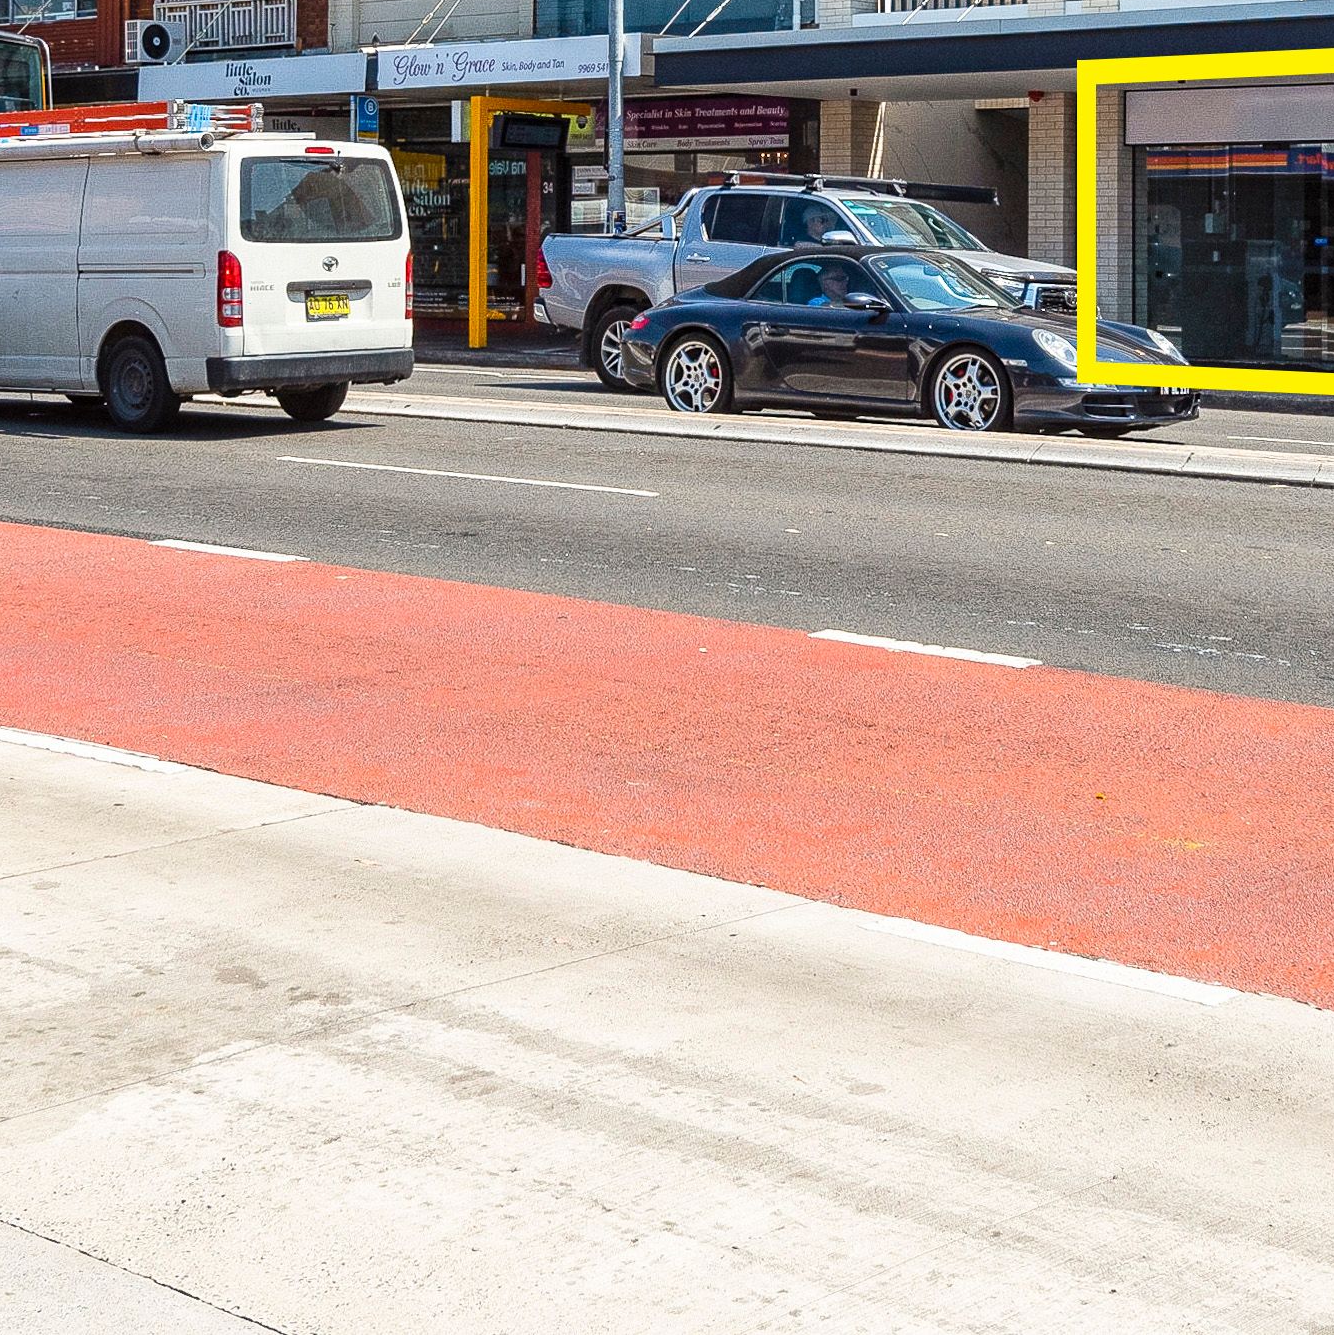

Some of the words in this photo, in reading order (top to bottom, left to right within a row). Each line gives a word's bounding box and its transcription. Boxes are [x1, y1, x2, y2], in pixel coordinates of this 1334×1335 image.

[225, 62, 253, 78] little
[393, 55, 431, 85] Glow
[452, 51, 495, 82] Grace
[519, 60, 536, 73] Body
[537, 60, 551, 70] and
[552, 59, 565, 70] Tan
[239, 72, 272, 86] salon
[626, 109, 662, 122] Specialist
[666, 109, 672, 117] in
[674, 108, 692, 118] Skin
[694, 106, 738, 117] Treatments
[740, 105, 755, 115] and
[756, 105, 785, 117] Beauty
[676, 139, 692, 149] Body
[694, 138, 731, 147] Treatments
[747, 137, 767, 147] Spray
[768, 137, 785, 145] Tans
[542, 182, 554, 194] 34
[413, 190, 451, 206] salon
